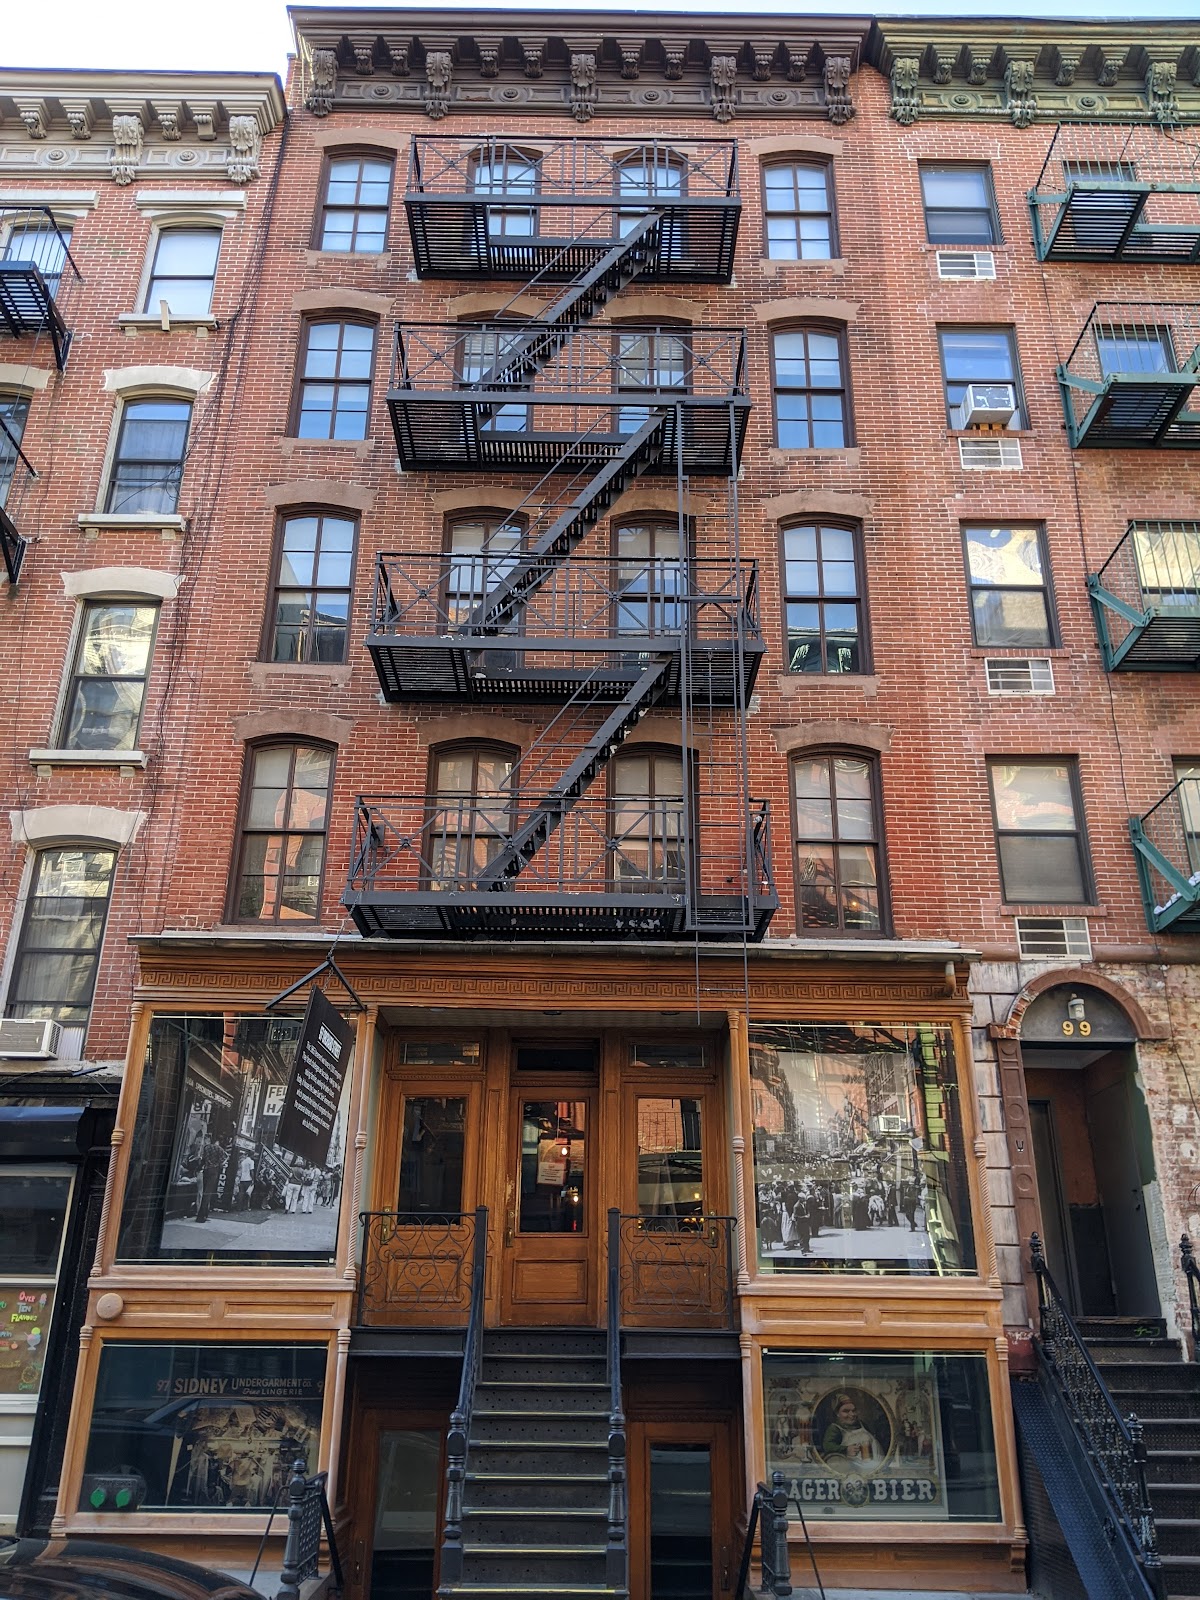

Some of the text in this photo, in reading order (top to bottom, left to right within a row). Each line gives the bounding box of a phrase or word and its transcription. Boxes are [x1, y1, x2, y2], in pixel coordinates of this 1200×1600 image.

[1062, 1020, 1092, 1037] 99
[216, 1162, 229, 1199] SIDNEY
[174, 1378, 228, 1394] SIDNEY
[788, 1479, 934, 1500] AGER BIER
